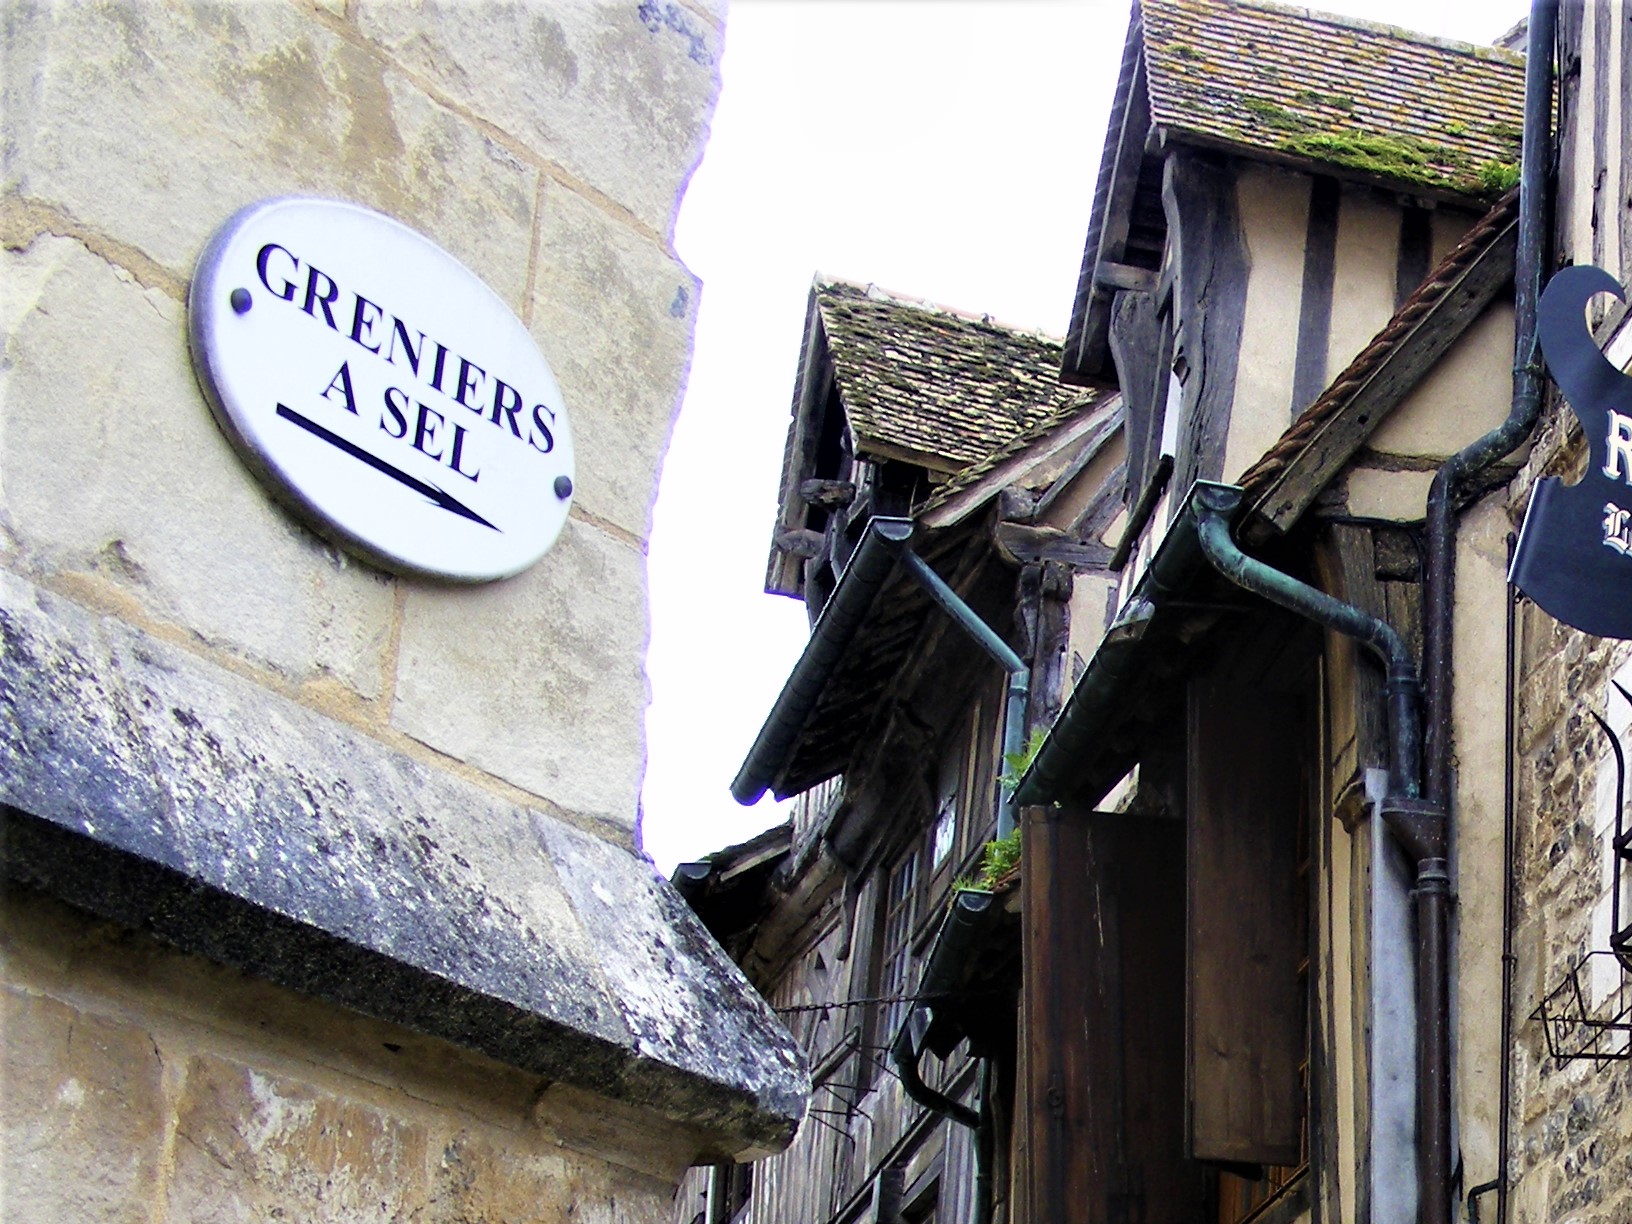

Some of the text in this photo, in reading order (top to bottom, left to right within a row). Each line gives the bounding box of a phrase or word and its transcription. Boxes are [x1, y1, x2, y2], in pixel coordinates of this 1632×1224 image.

[255, 243, 558, 455] GRENIERS
[320, 359, 482, 484] A SEL
